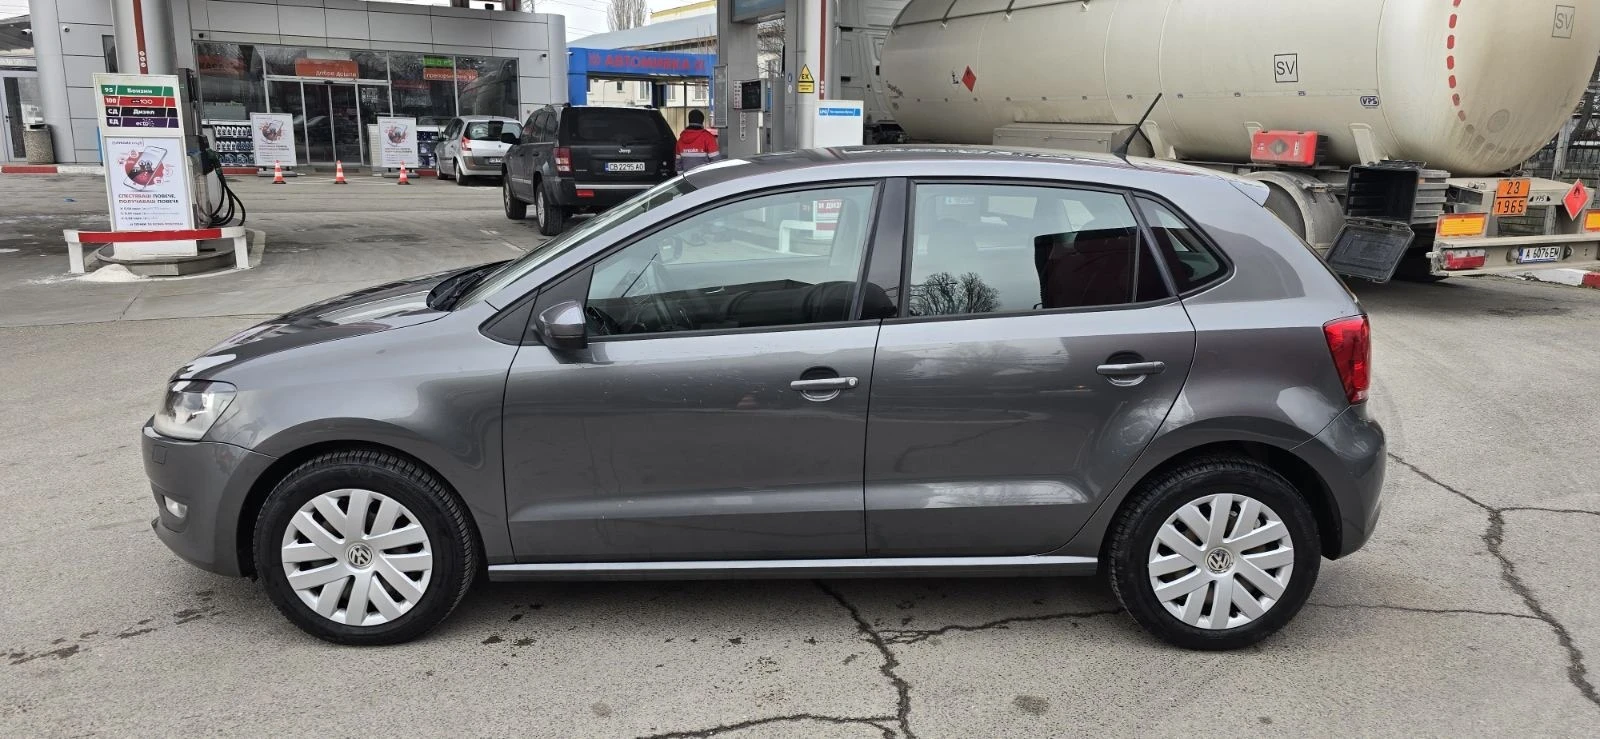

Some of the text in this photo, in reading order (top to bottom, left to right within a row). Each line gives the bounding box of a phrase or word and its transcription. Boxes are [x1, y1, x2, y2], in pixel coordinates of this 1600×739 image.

[1555, 12, 1574, 29] SV
[605, 55, 690, 70] АВТОМИВКА
[1276, 61, 1295, 75] SV
[1362, 97, 1378, 105] VPS
[1506, 181, 1520, 195] 23
[1497, 200, 1524, 213] 1965
[1525, 247, 1560, 258] A 6076 EM
